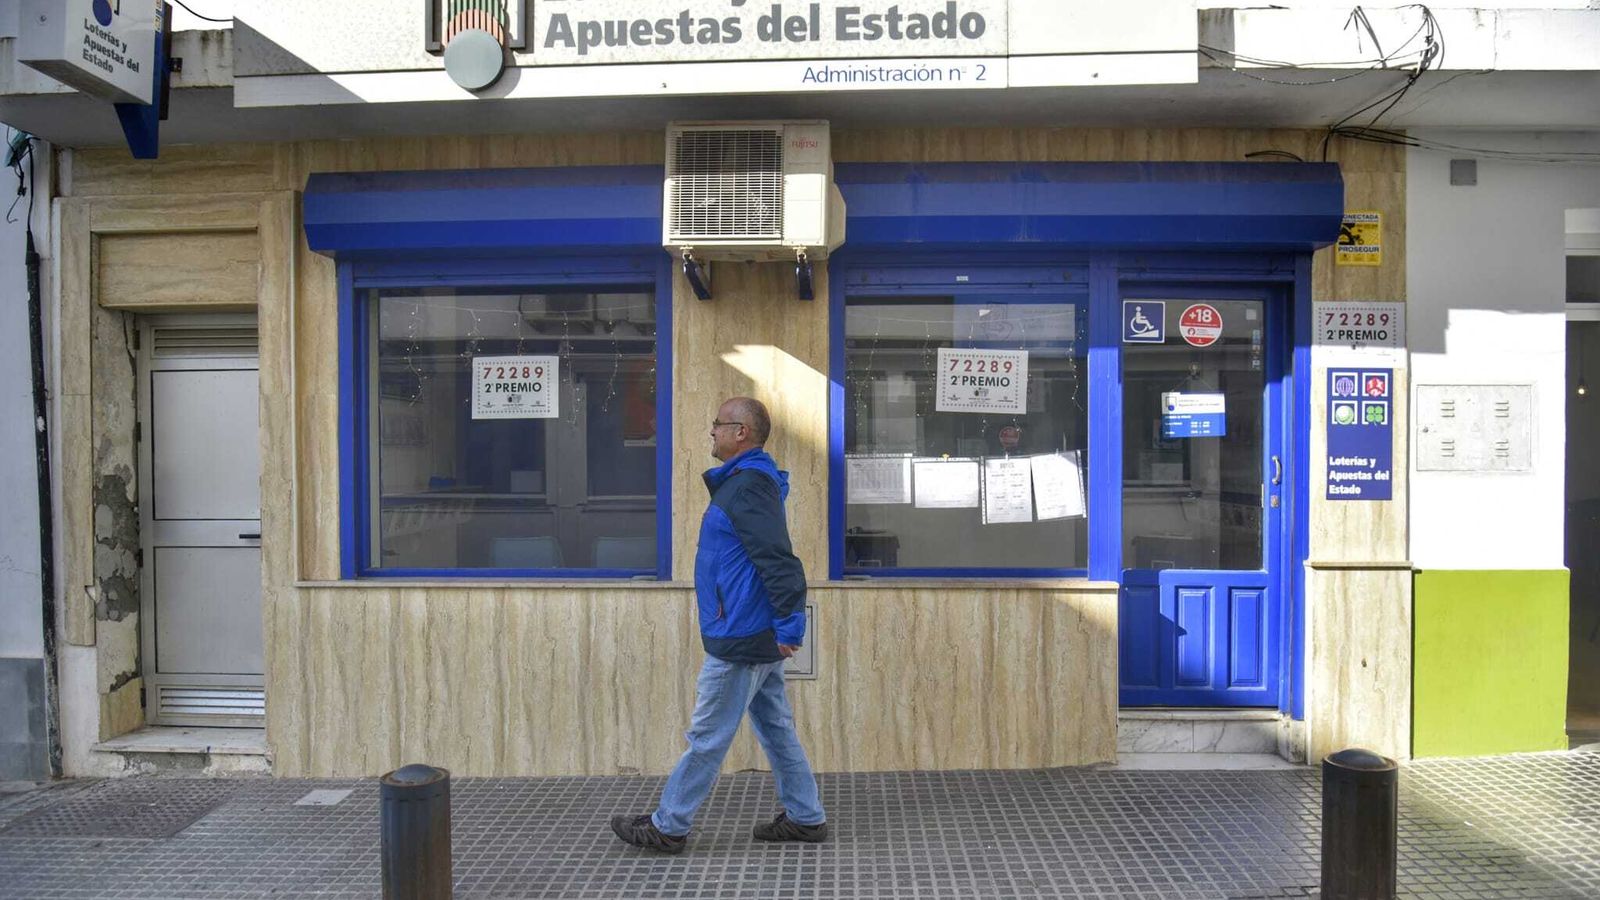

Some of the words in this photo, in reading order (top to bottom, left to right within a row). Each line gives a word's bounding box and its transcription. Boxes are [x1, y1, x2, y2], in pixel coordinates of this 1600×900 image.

[543, 9, 742, 56] Apuestas
[757, 3, 820, 42] del
[835, 1, 986, 41] Estado
[84, 18, 120, 47] Loterías
[121, 43, 128, 54] y
[82, 48, 114, 73] Estado
[83, 35, 125, 65] Apuestas
[126, 59, 140, 73] del
[802, 64, 943, 84] Administración
[975, 64, 987, 81] 2
[1188, 309, 1213, 323] +18
[1324, 313, 1390, 326] 72289
[1338, 329, 1388, 341] PREMIO
[483, 366, 544, 379] 72289
[949, 359, 1013, 373] 72289
[495, 382, 542, 393] PREMIO
[961, 375, 1010, 387] PREMIO
[1329, 455, 1368, 466] Loterías
[1369, 458, 1376, 468] y
[1329, 470, 1372, 482] Apuestas
[1374, 470, 1389, 480] del
[1329, 484, 1362, 495] Estado
